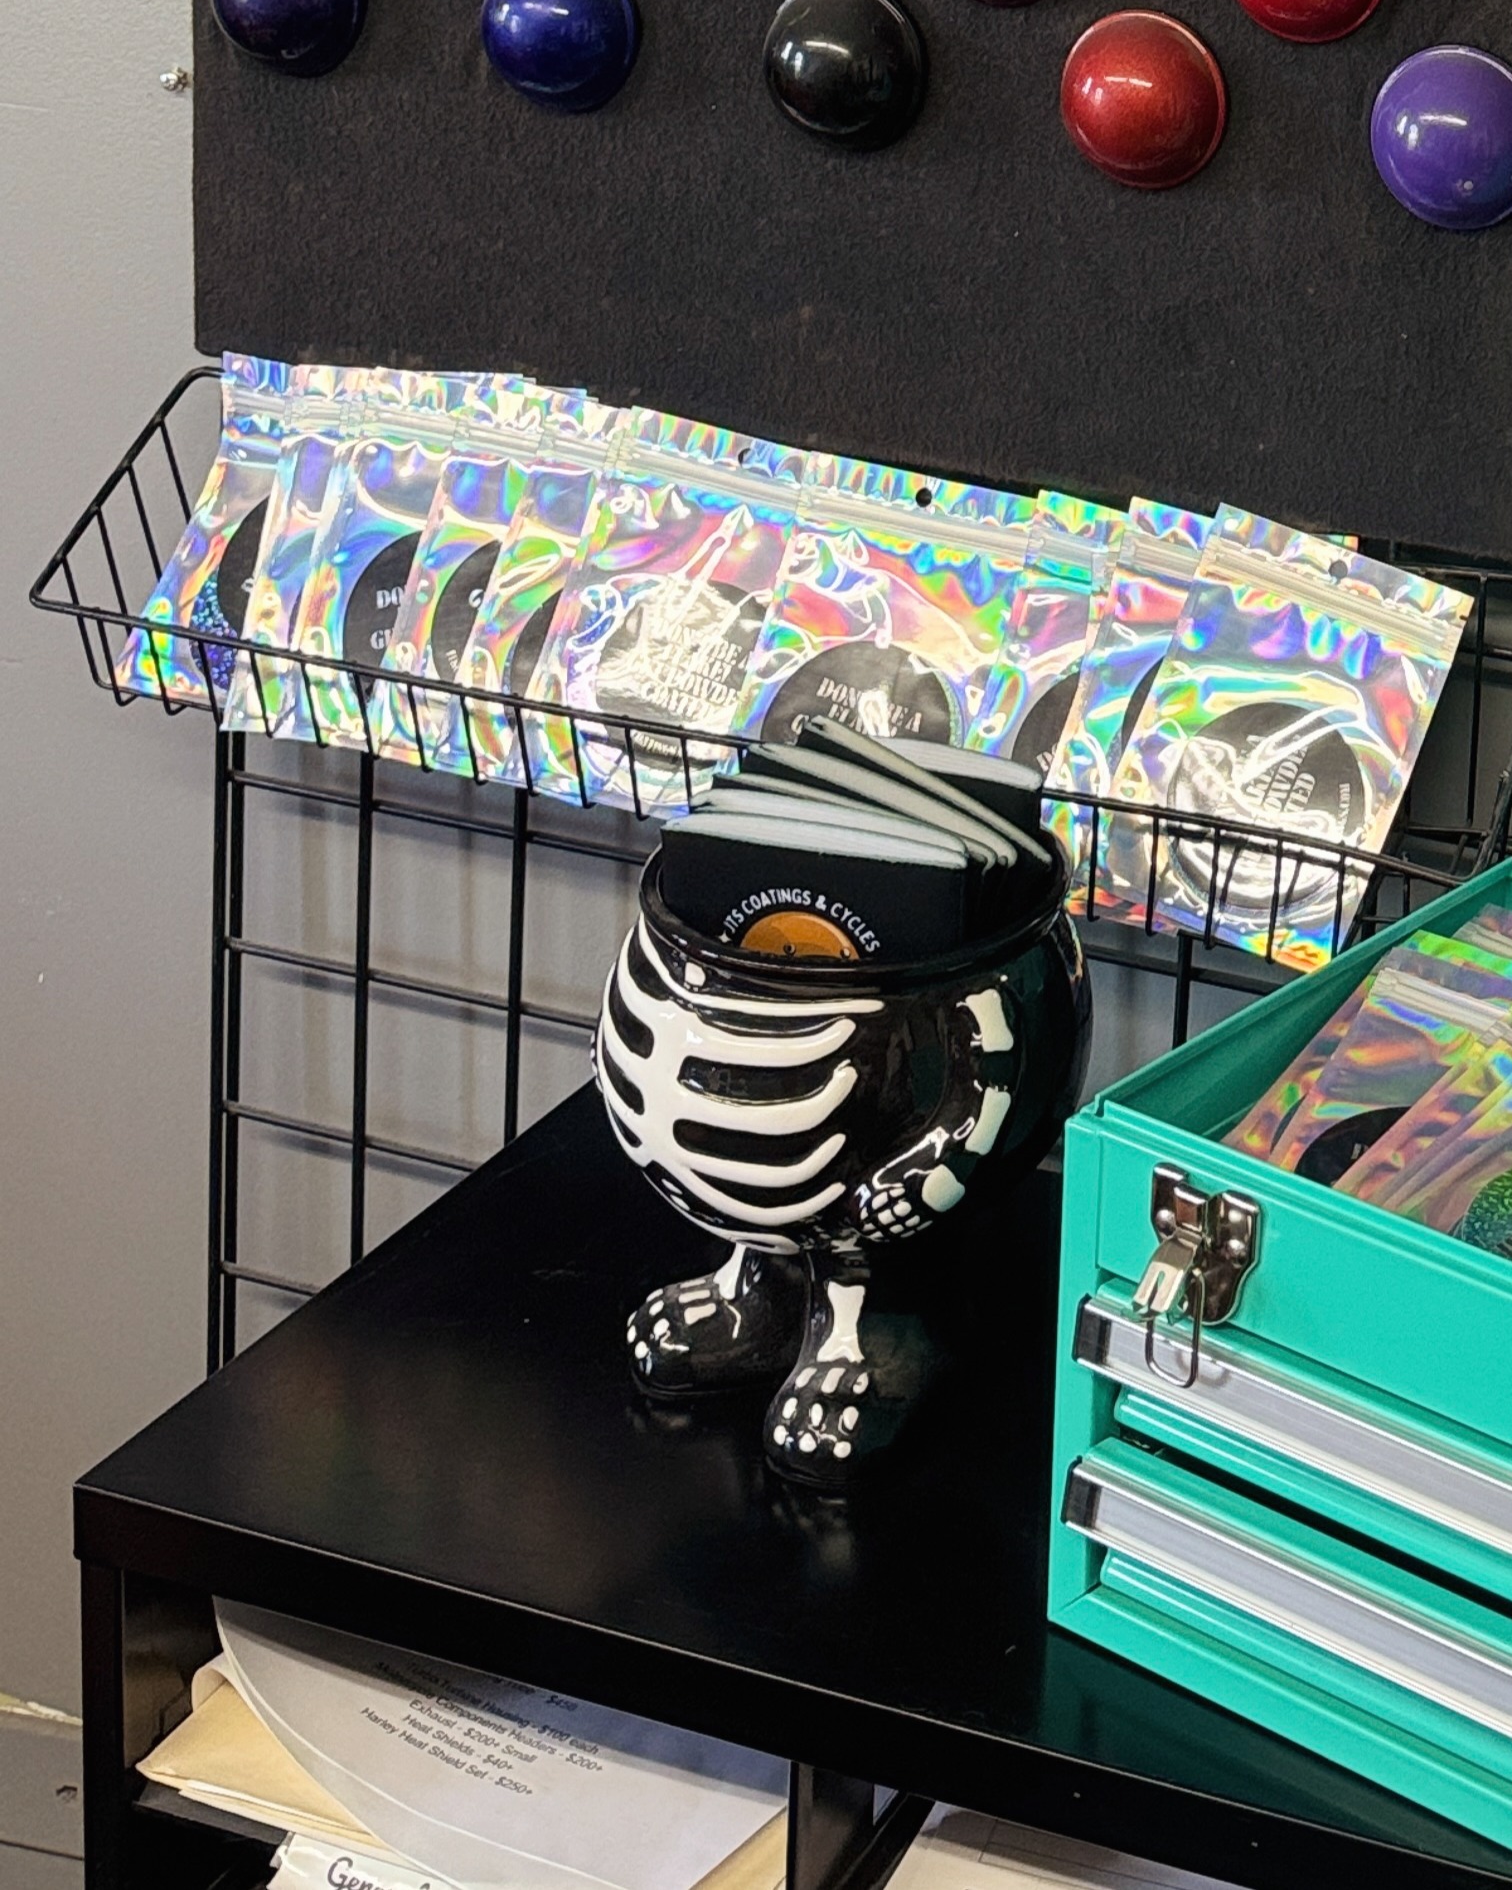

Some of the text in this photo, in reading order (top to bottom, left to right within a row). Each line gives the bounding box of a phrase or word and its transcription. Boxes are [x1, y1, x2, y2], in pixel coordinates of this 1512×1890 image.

[724, 888, 880, 952] JTS COATINGS & CYCLES
[361, 1707, 399, 1735] Harley
[399, 1730, 428, 1750] Heat
[428, 1744, 464, 1770] Shield
[465, 1764, 487, 1780] Set
[495, 1776, 533, 1795] $250+
[403, 1714, 430, 1734] Heat
[433, 1730, 474, 1757] Shields
[482, 1754, 513, 1770] $40+
[409, 1699, 456, 1729] Exhaust
[464, 1727, 501, 1748] $200+
[502, 1745, 538, 1763] Small
[436, 1696, 507, 1734] Components
[508, 1729, 557, 1756] Headers
[565, 1753, 603, 1772] $200+
